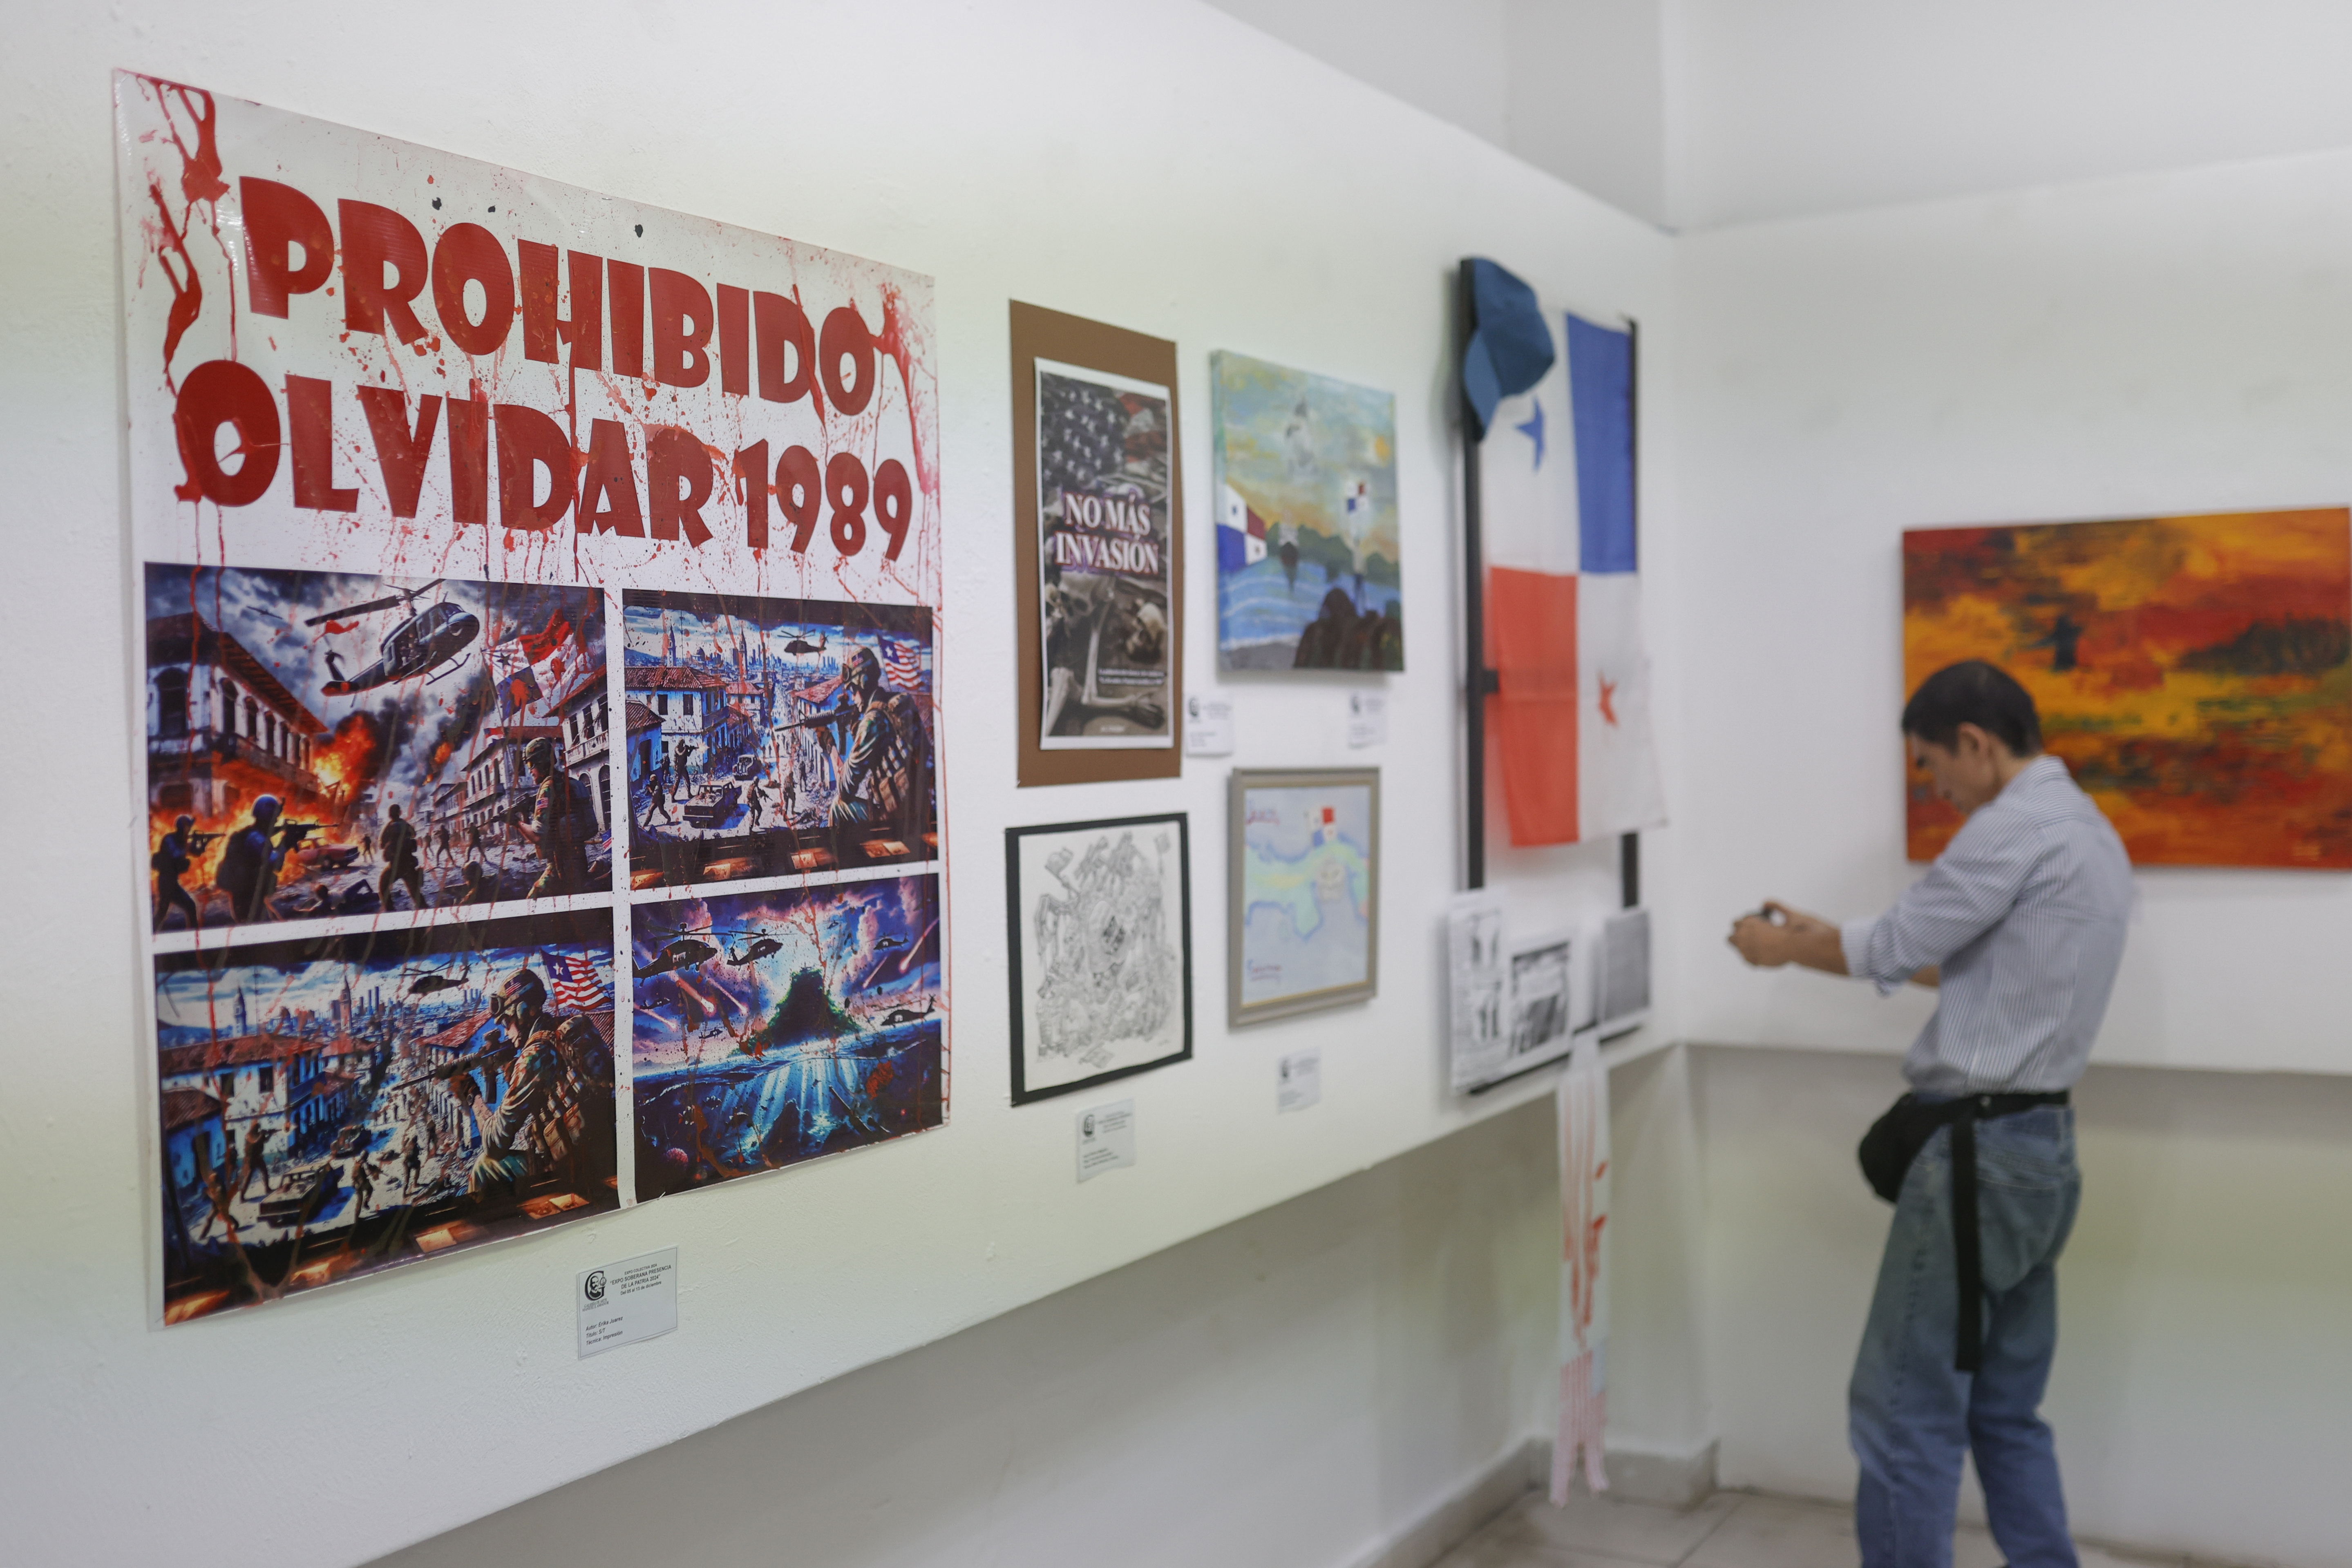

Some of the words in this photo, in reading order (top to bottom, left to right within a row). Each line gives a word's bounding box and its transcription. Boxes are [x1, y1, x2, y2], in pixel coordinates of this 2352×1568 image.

[239, 175, 876, 416] PROHIBIDO
[174, 360, 718, 549] OLVIDAR
[736, 437, 913, 562] 1989
[1064, 492, 1102, 529] NO
[1104, 492, 1151, 536] MÁS
[1055, 531, 1159, 575] INVASIÓN
[624, 1271, 648, 1282] SOBERANA
[648, 1265, 671, 1275] PRESENCIA
[635, 1278, 649, 1286] PATRIA
[646, 1280, 662, 1289] diciembre
[603, 1331, 623, 1340] Impresión
